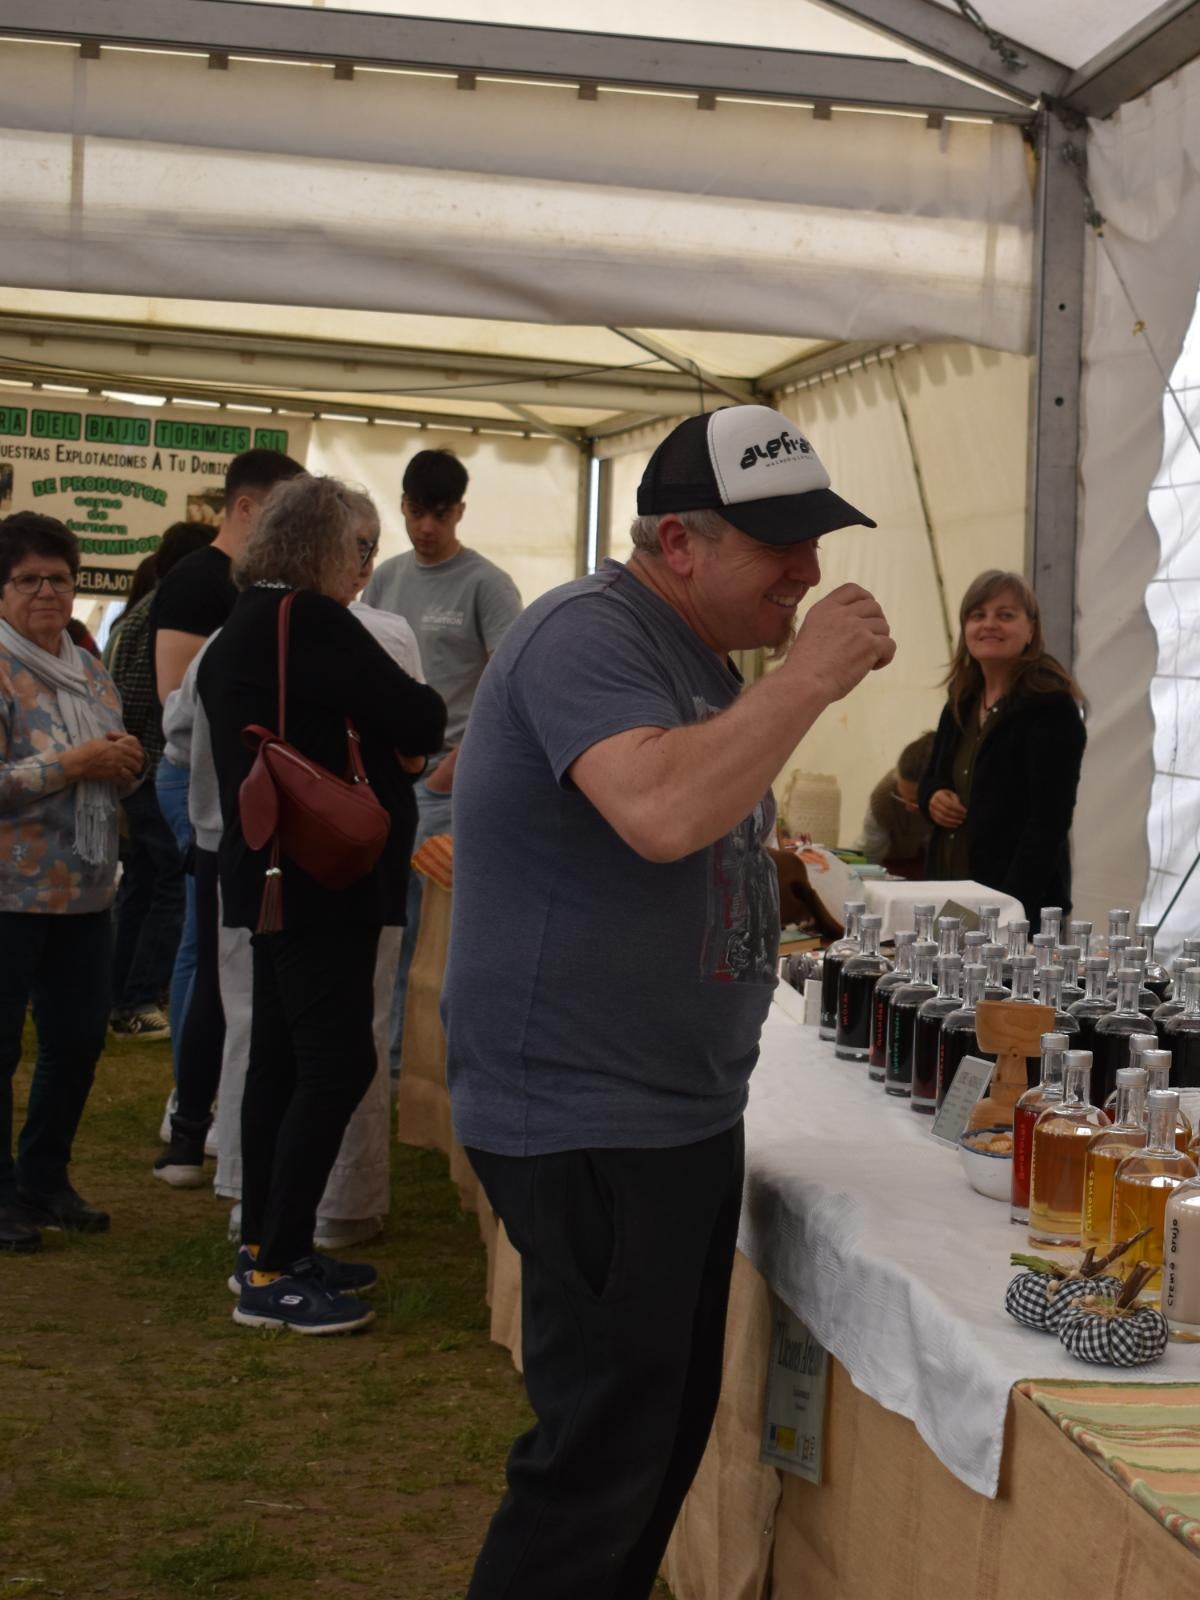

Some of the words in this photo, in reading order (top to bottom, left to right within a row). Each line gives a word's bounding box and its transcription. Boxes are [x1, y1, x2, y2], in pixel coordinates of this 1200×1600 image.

[35, 413, 77, 437] DEL
[88, 418, 147, 443] BAJO
[158, 423, 248, 451] TORMES
[152, 451, 162, 471] A
[31, 477, 57, 498] DE
[60, 475, 168, 508] PRODUCTOR
[74, 496, 123, 510] carne
[87, 507, 109, 521] de
